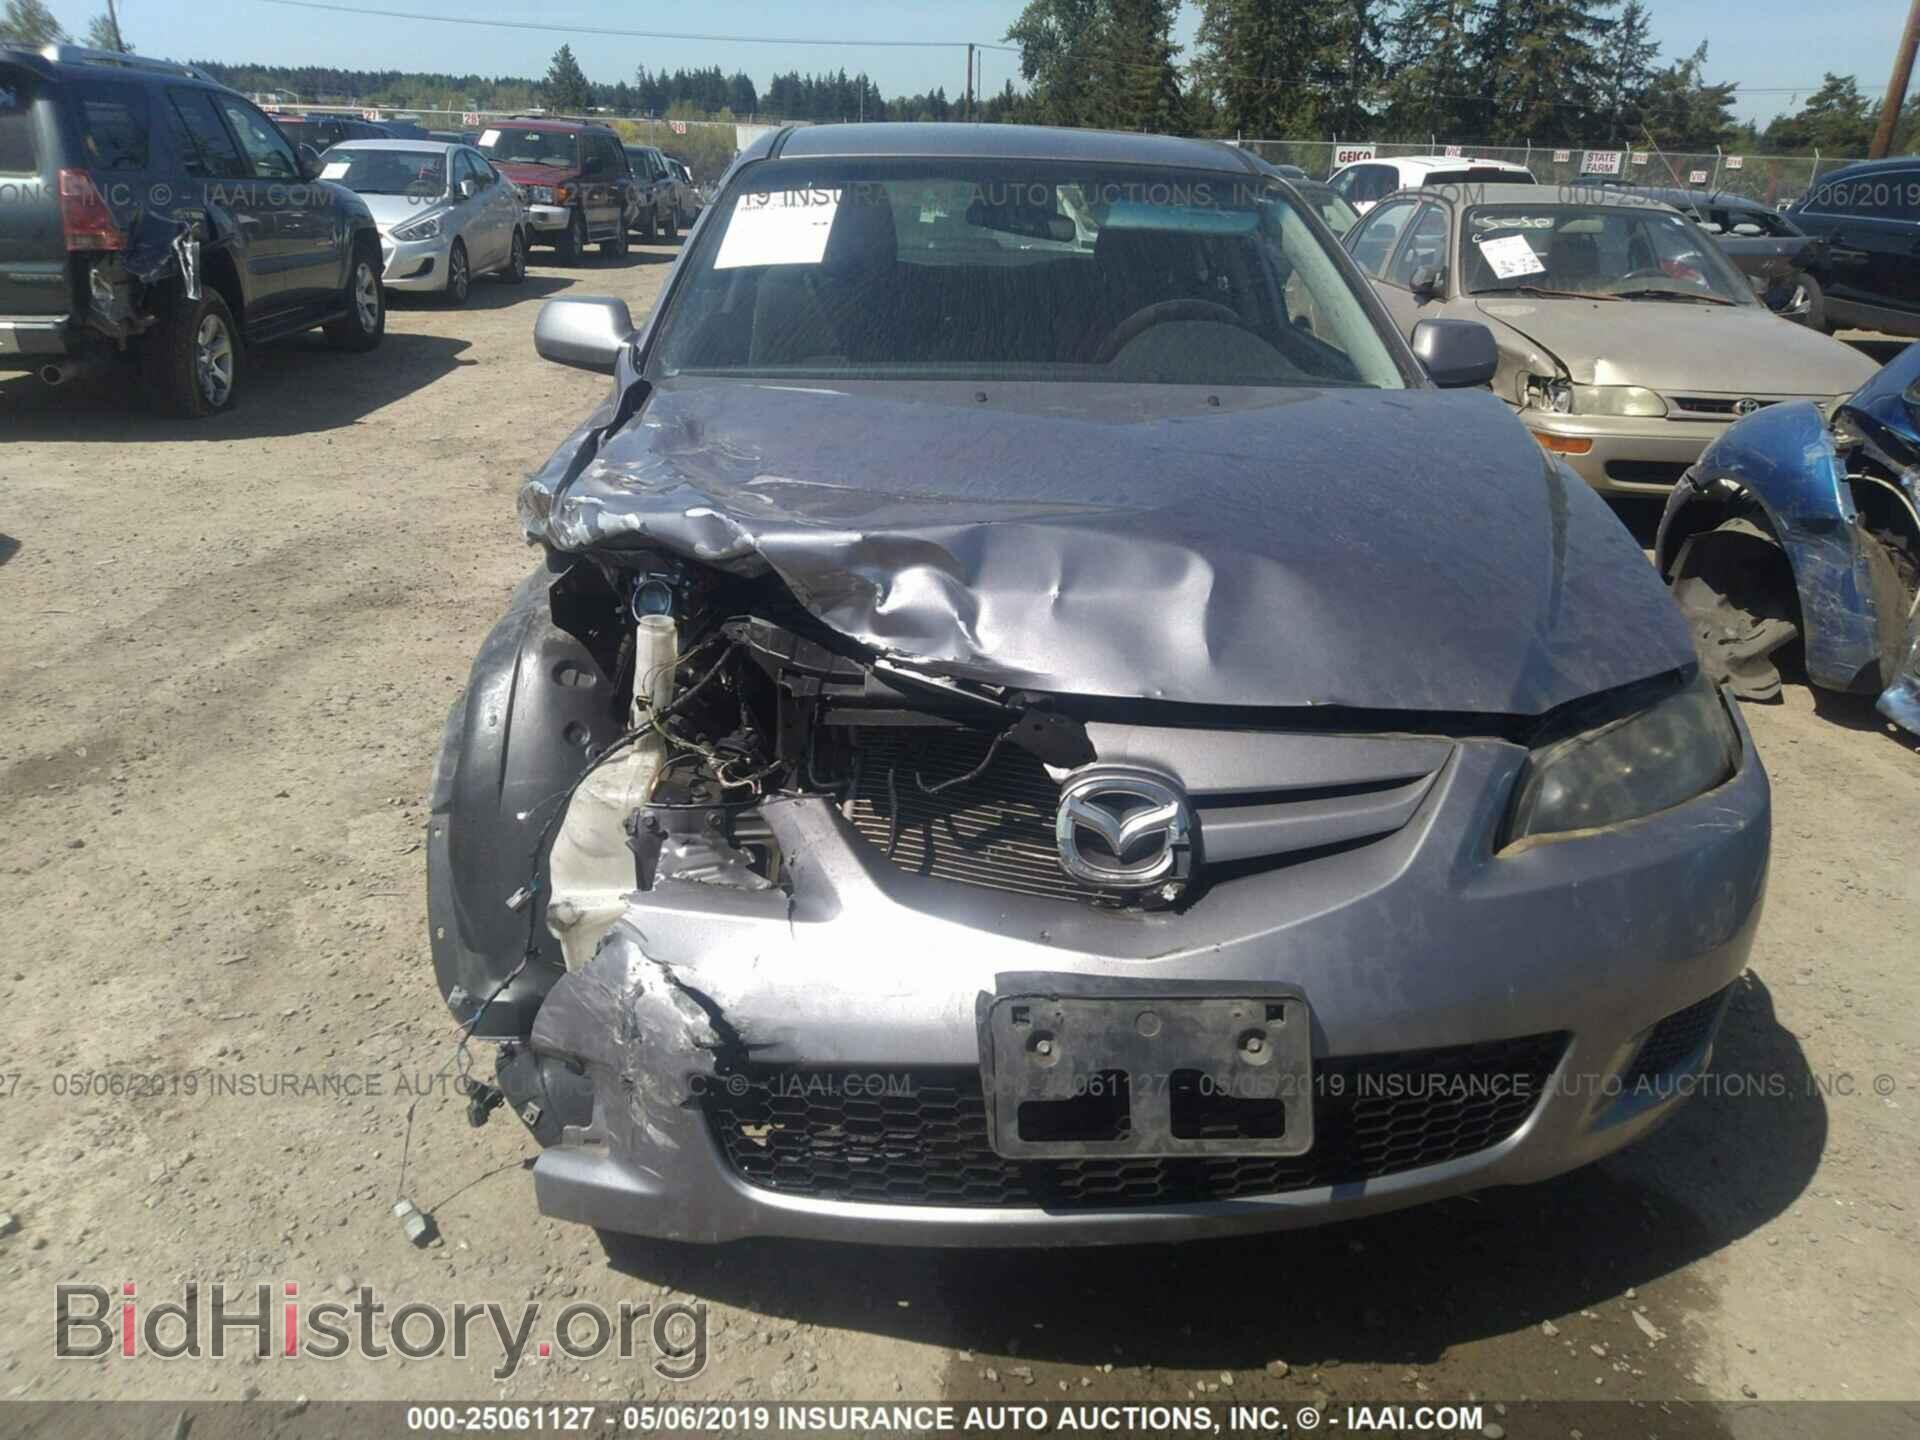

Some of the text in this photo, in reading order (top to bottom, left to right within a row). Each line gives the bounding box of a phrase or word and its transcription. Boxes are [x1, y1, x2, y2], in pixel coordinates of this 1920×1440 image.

[1338, 150, 1372, 163] GEICO
[1586, 152, 1616, 162] STATE
[1585, 163, 1614, 173] FARM
